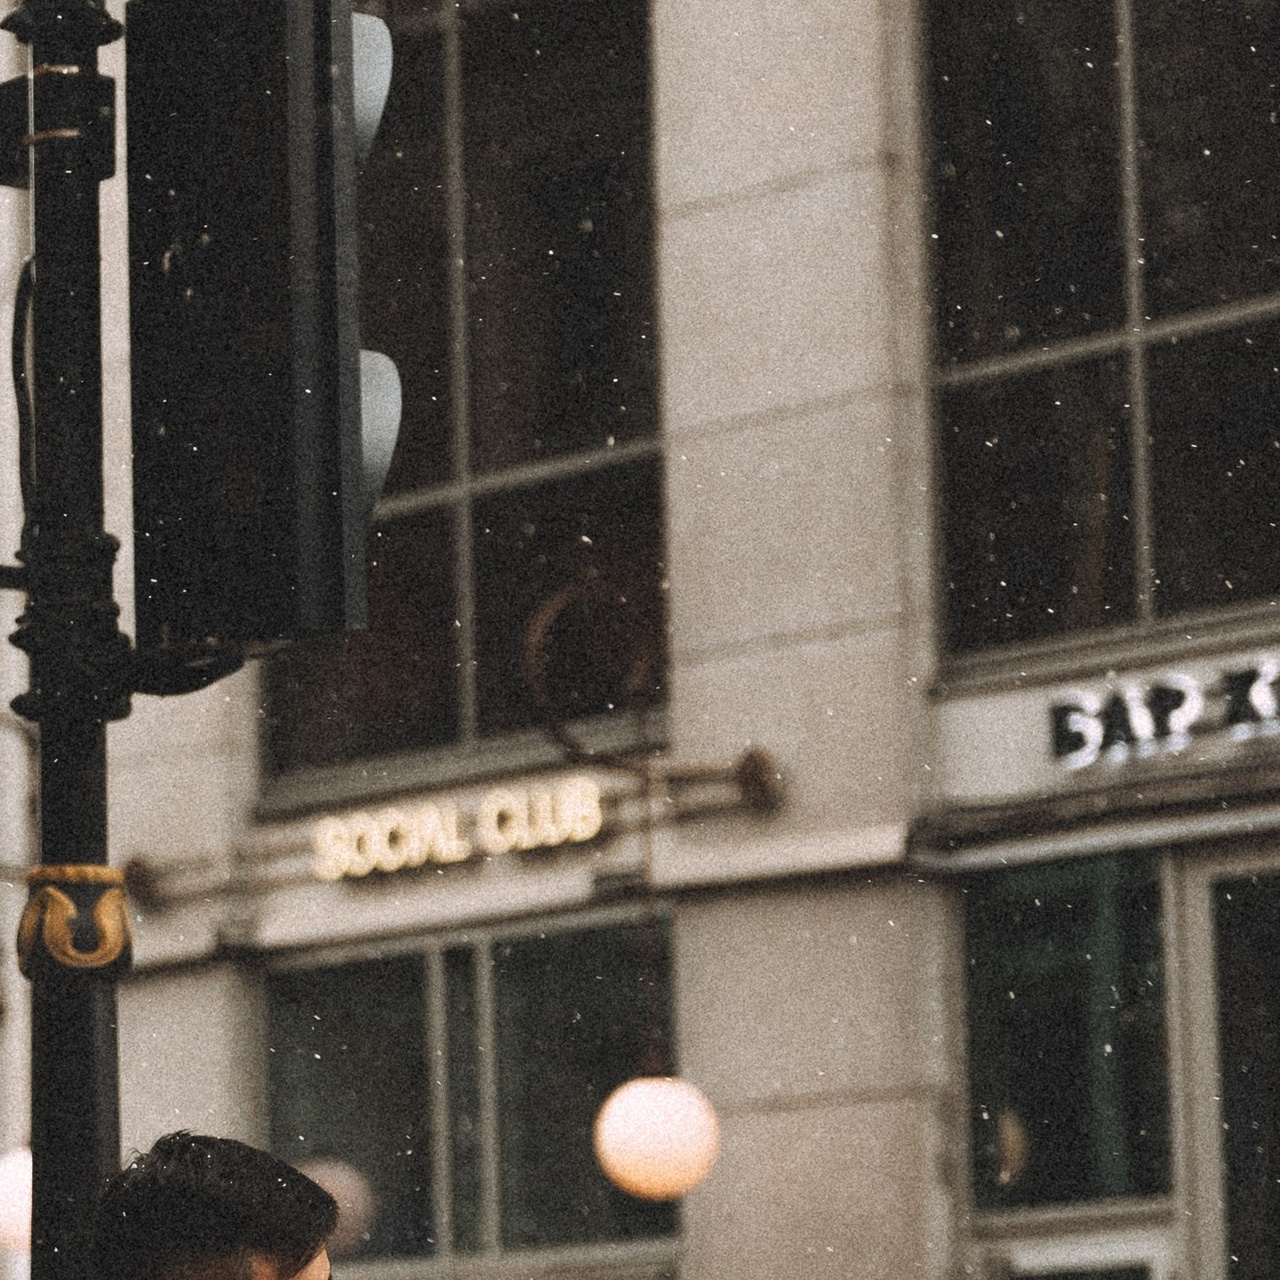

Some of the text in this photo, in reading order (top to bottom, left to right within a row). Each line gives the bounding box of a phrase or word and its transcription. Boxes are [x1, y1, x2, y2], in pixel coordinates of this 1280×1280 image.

[1050, 675, 1204, 768] БАР
[315, 775, 602, 879] SOCIAL CLUB
